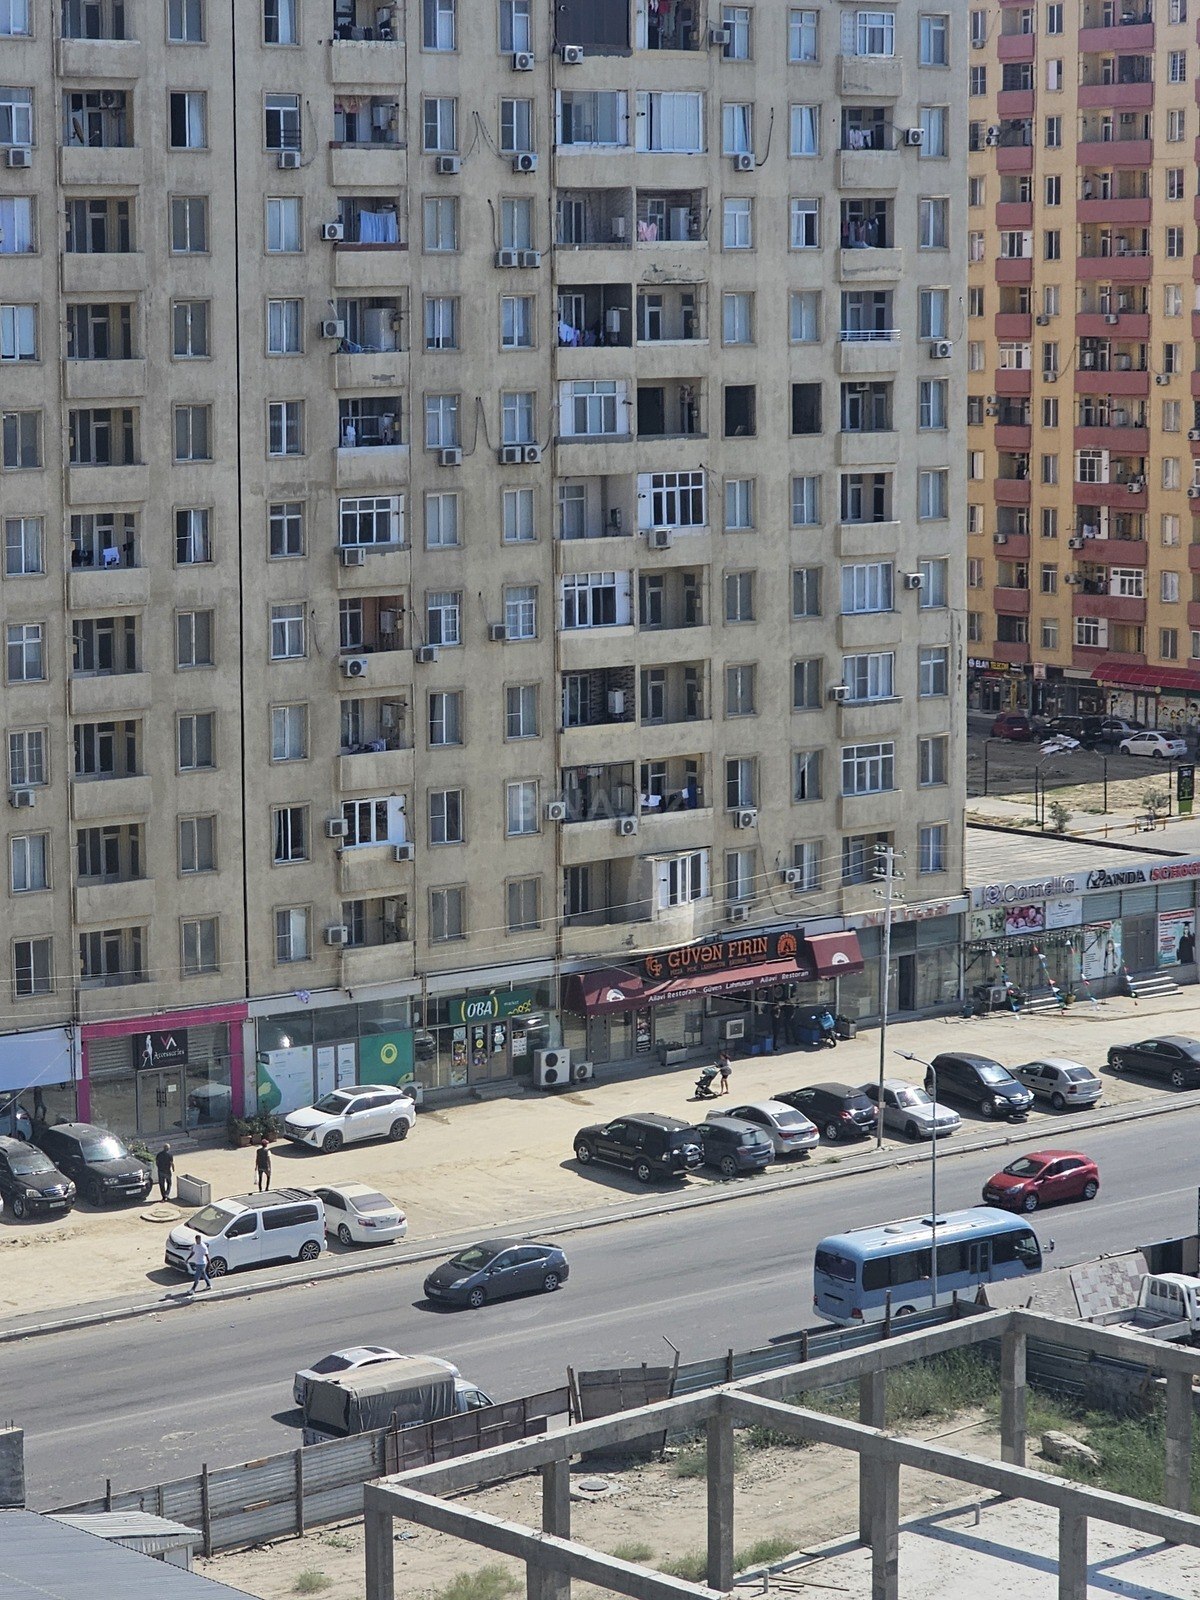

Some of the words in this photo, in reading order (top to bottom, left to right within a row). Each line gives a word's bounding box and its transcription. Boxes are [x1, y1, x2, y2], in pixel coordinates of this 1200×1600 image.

[1087, 869, 1147, 889] PANDA
[1150, 861, 1200, 881] SCHOO
[668, 944, 723, 967] GÜVƏN
[667, 988, 697, 999] Restoran
[782, 970, 809, 980] Restoran
